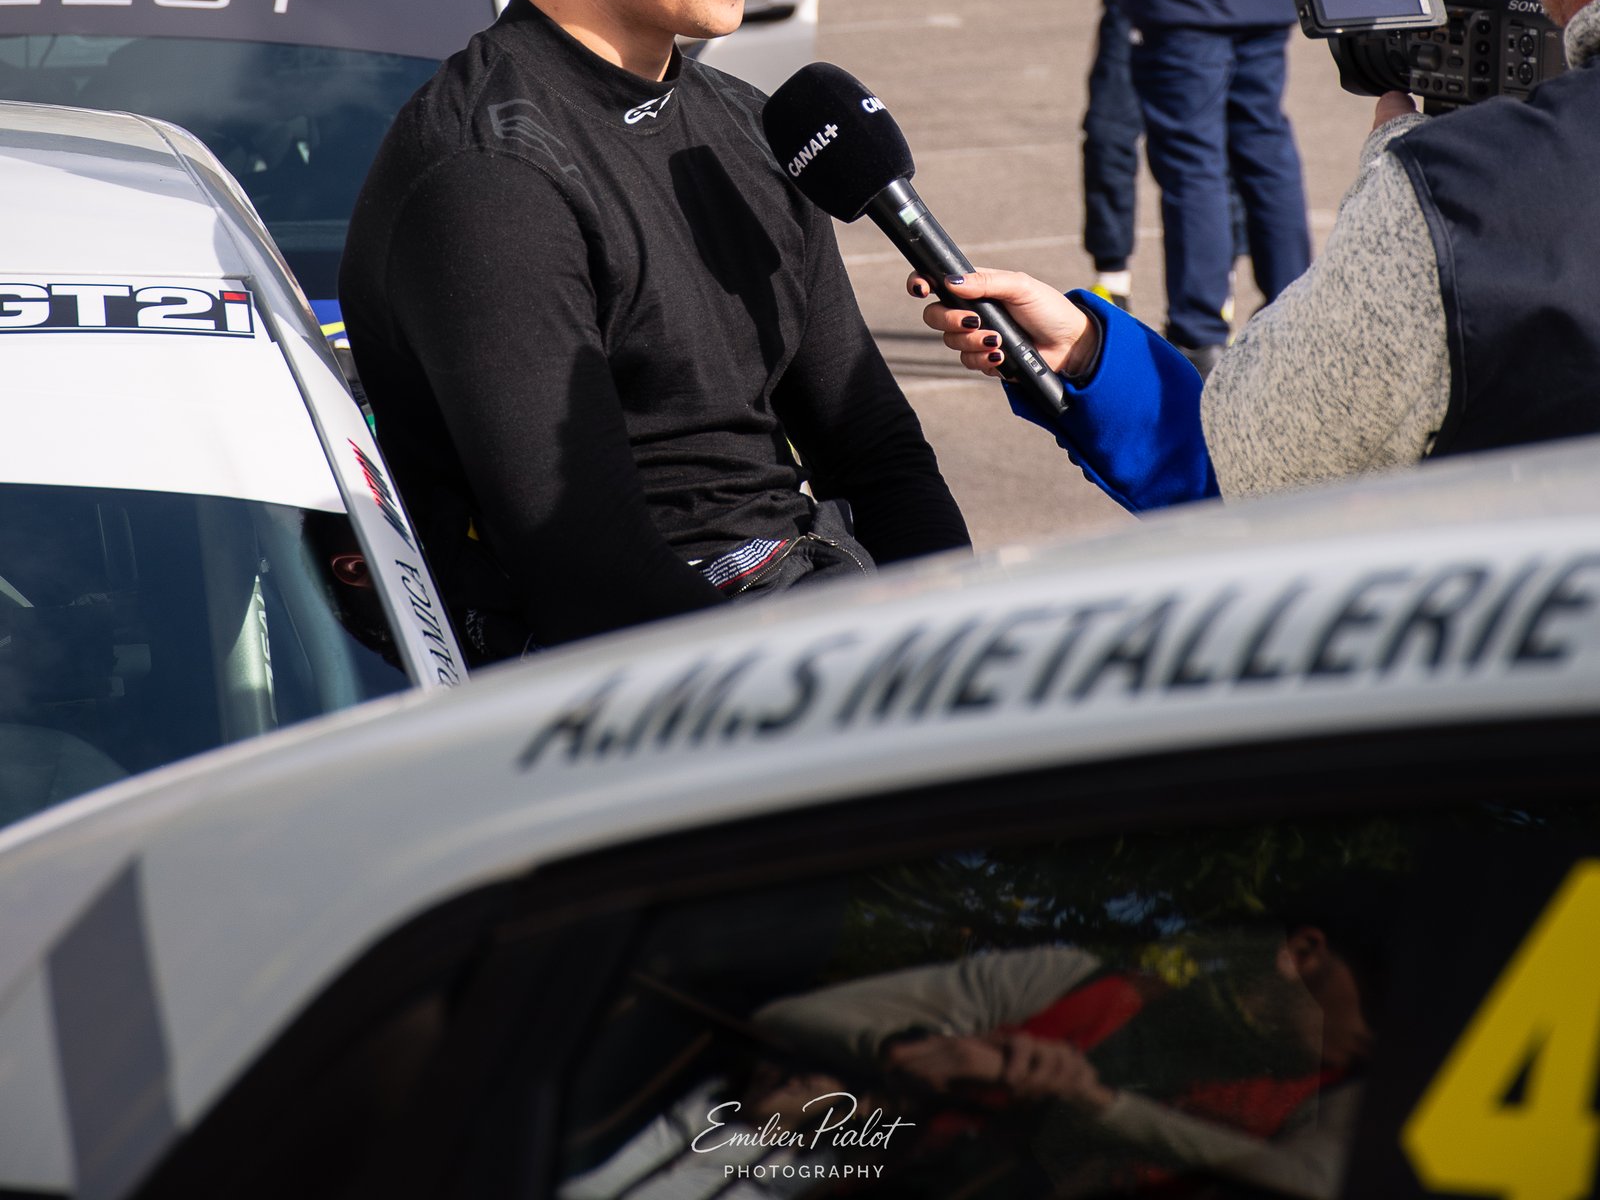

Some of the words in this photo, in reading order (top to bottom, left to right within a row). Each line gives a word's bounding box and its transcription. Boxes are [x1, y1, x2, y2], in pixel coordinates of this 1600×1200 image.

[787, 123, 839, 178] CANAL+
[0, 283, 252, 334] GT2i
[518, 632, 860, 772] A.M.S
[835, 550, 1600, 728] METALLERIE
